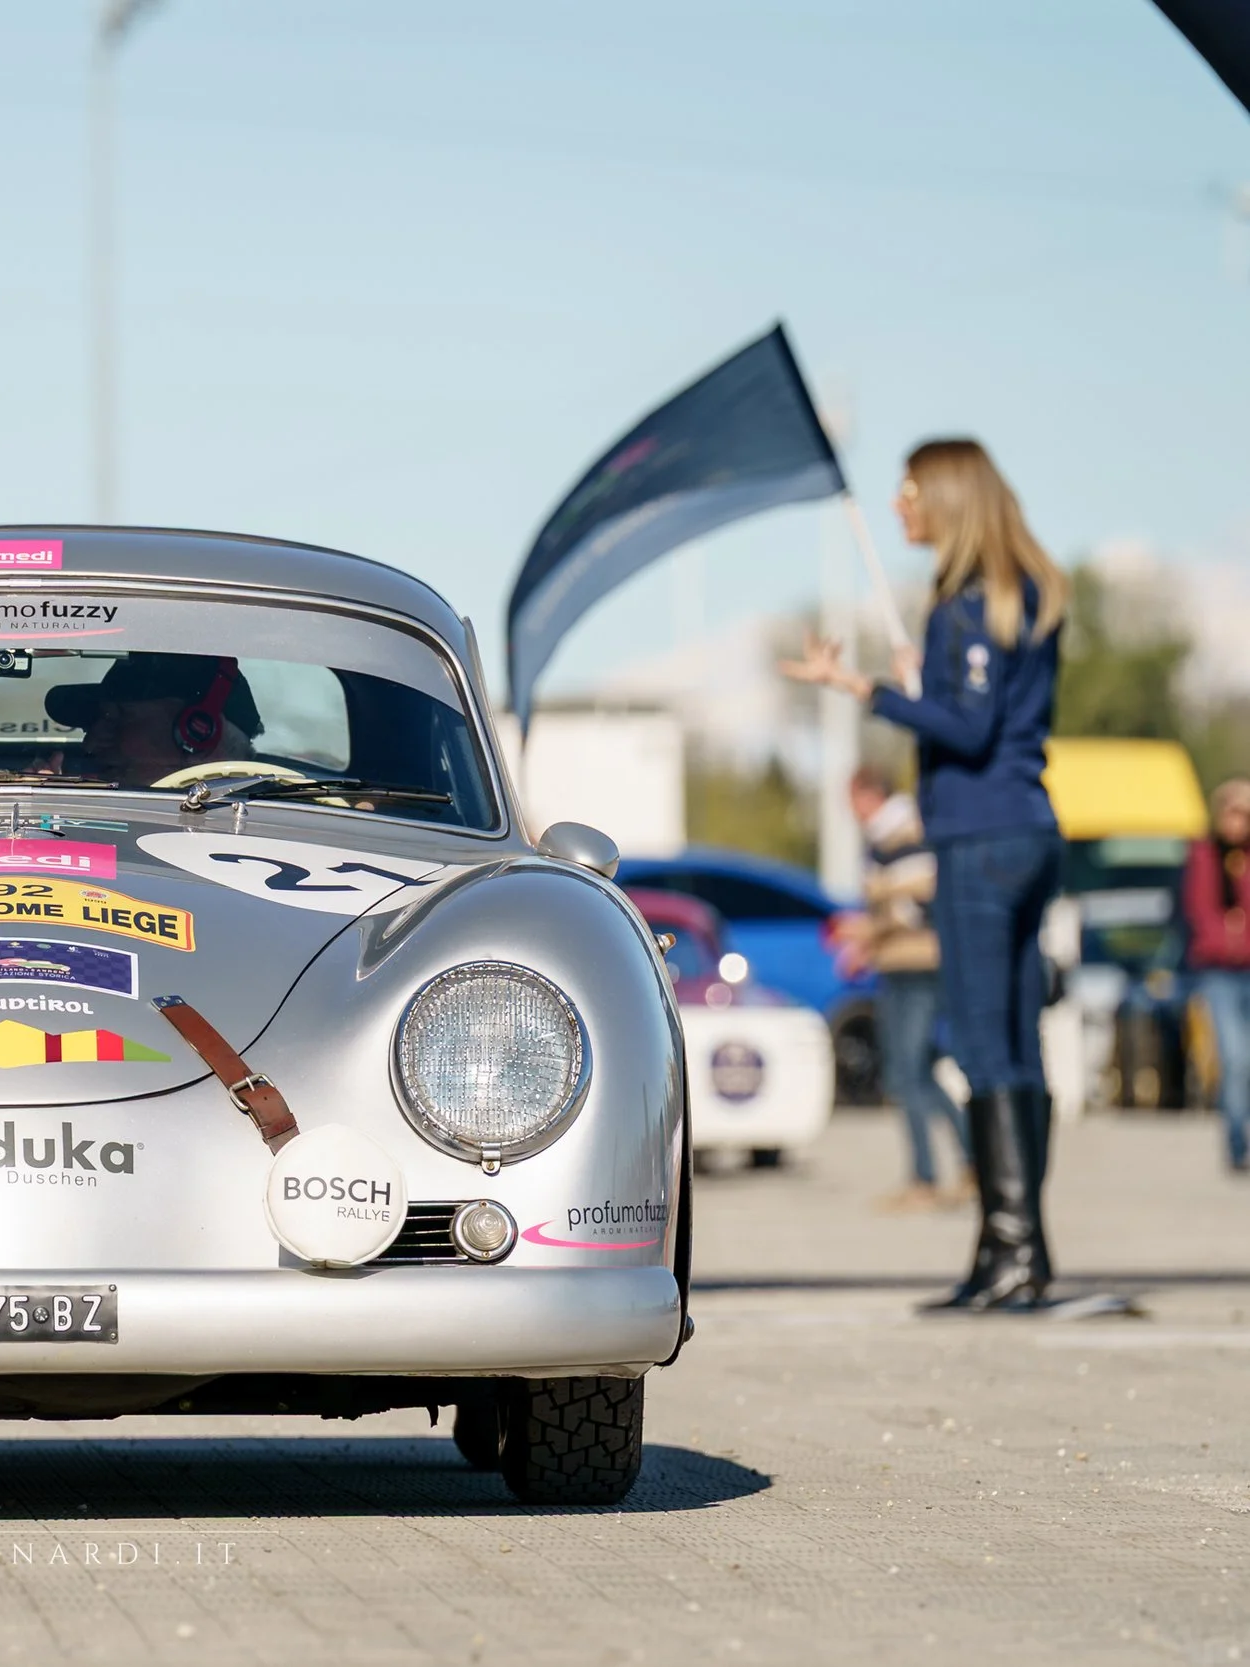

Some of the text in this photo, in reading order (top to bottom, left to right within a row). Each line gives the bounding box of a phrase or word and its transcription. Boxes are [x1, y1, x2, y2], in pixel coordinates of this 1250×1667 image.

[10, 621, 86, 630] NATURALI
[209, 853, 444, 891] 21
[82, 906, 179, 940] LIEGE
[7, 1170, 98, 1188] Duschen
[284, 1176, 391, 1206] BOSCH
[337, 1206, 390, 1222] RALLYE
